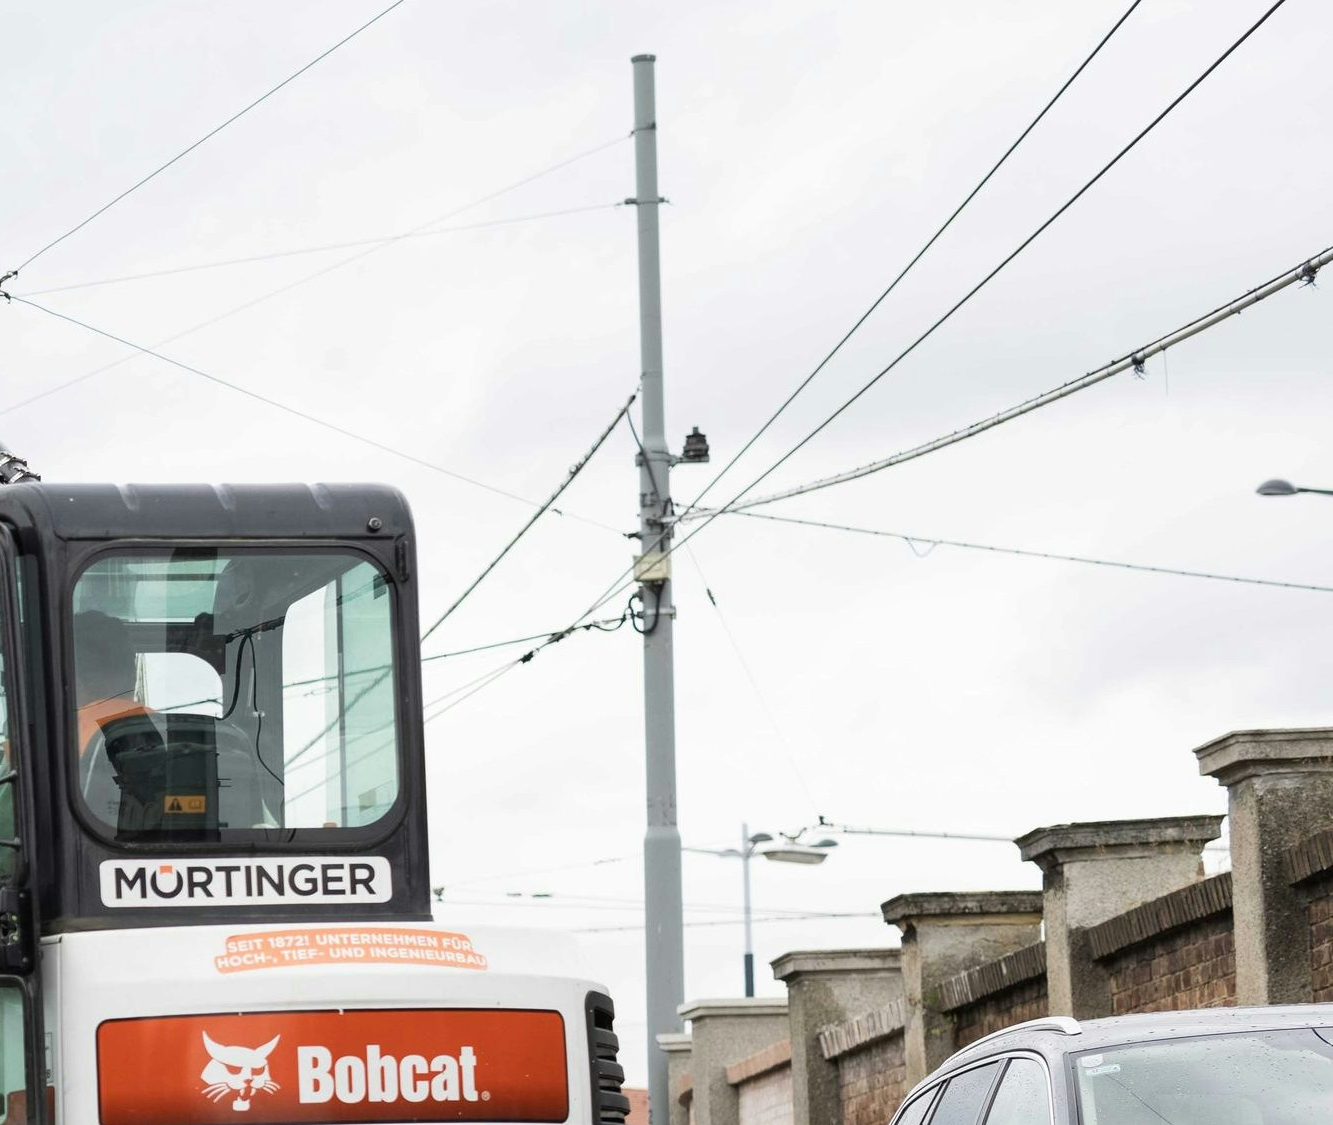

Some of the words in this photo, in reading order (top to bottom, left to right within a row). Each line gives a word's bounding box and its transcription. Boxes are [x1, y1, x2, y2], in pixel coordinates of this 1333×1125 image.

[114, 863, 377, 899] MÖRTINGER
[227, 939, 263, 953] SEIT
[268, 935, 310, 948] 1872!
[315, 933, 438, 947] UNTERNEHMEN
[442, 936, 475, 951] FÜR
[217, 952, 278, 968] HOCH-,
[280, 949, 325, 961] TIEF-
[328, 947, 366, 959] UND
[369, 947, 486, 966] INGENIEURBAU
[297, 1044, 479, 1104] Bobcat
